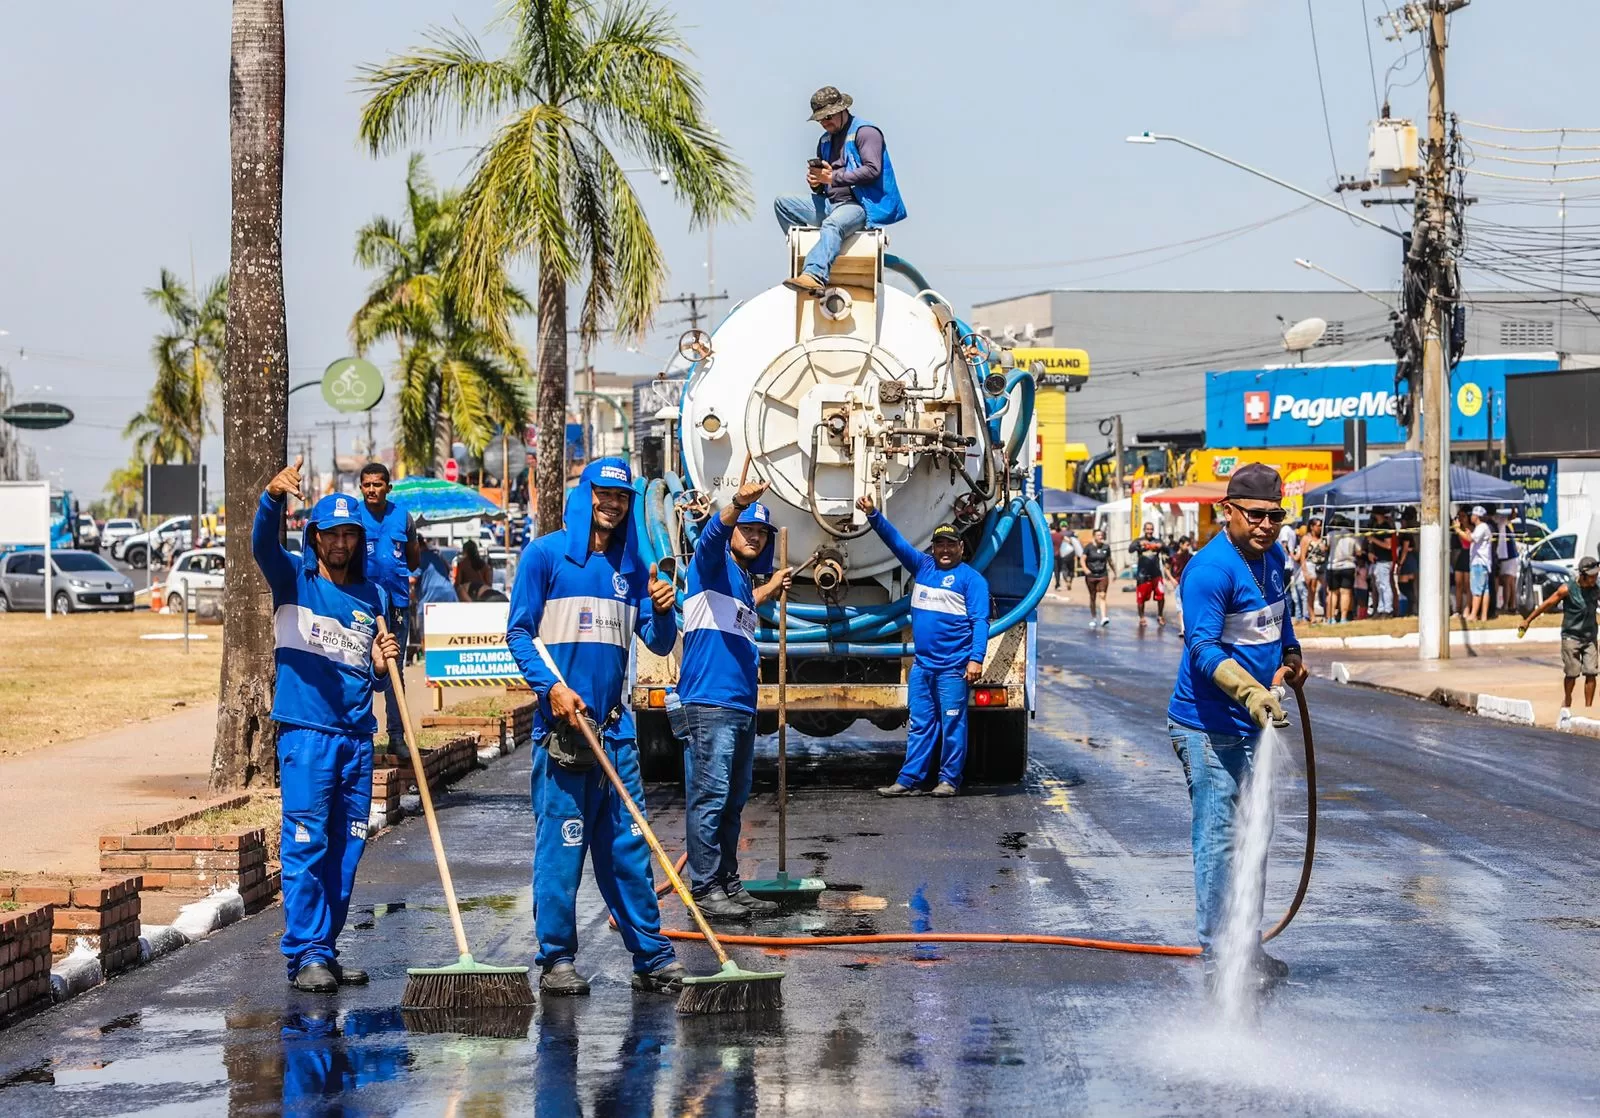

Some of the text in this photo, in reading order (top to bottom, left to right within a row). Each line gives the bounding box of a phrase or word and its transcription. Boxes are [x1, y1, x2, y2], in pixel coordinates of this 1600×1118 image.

[1028, 358, 1081, 368] LLAND
[1272, 391, 1426, 427] PagueMe
[1509, 463, 1549, 478] Compre
[322, 635, 339, 646] RIO
[447, 632, 507, 646] ATENÇ
[459, 651, 512, 664] ESTAMOS
[444, 662, 520, 676] TRABALHAND
